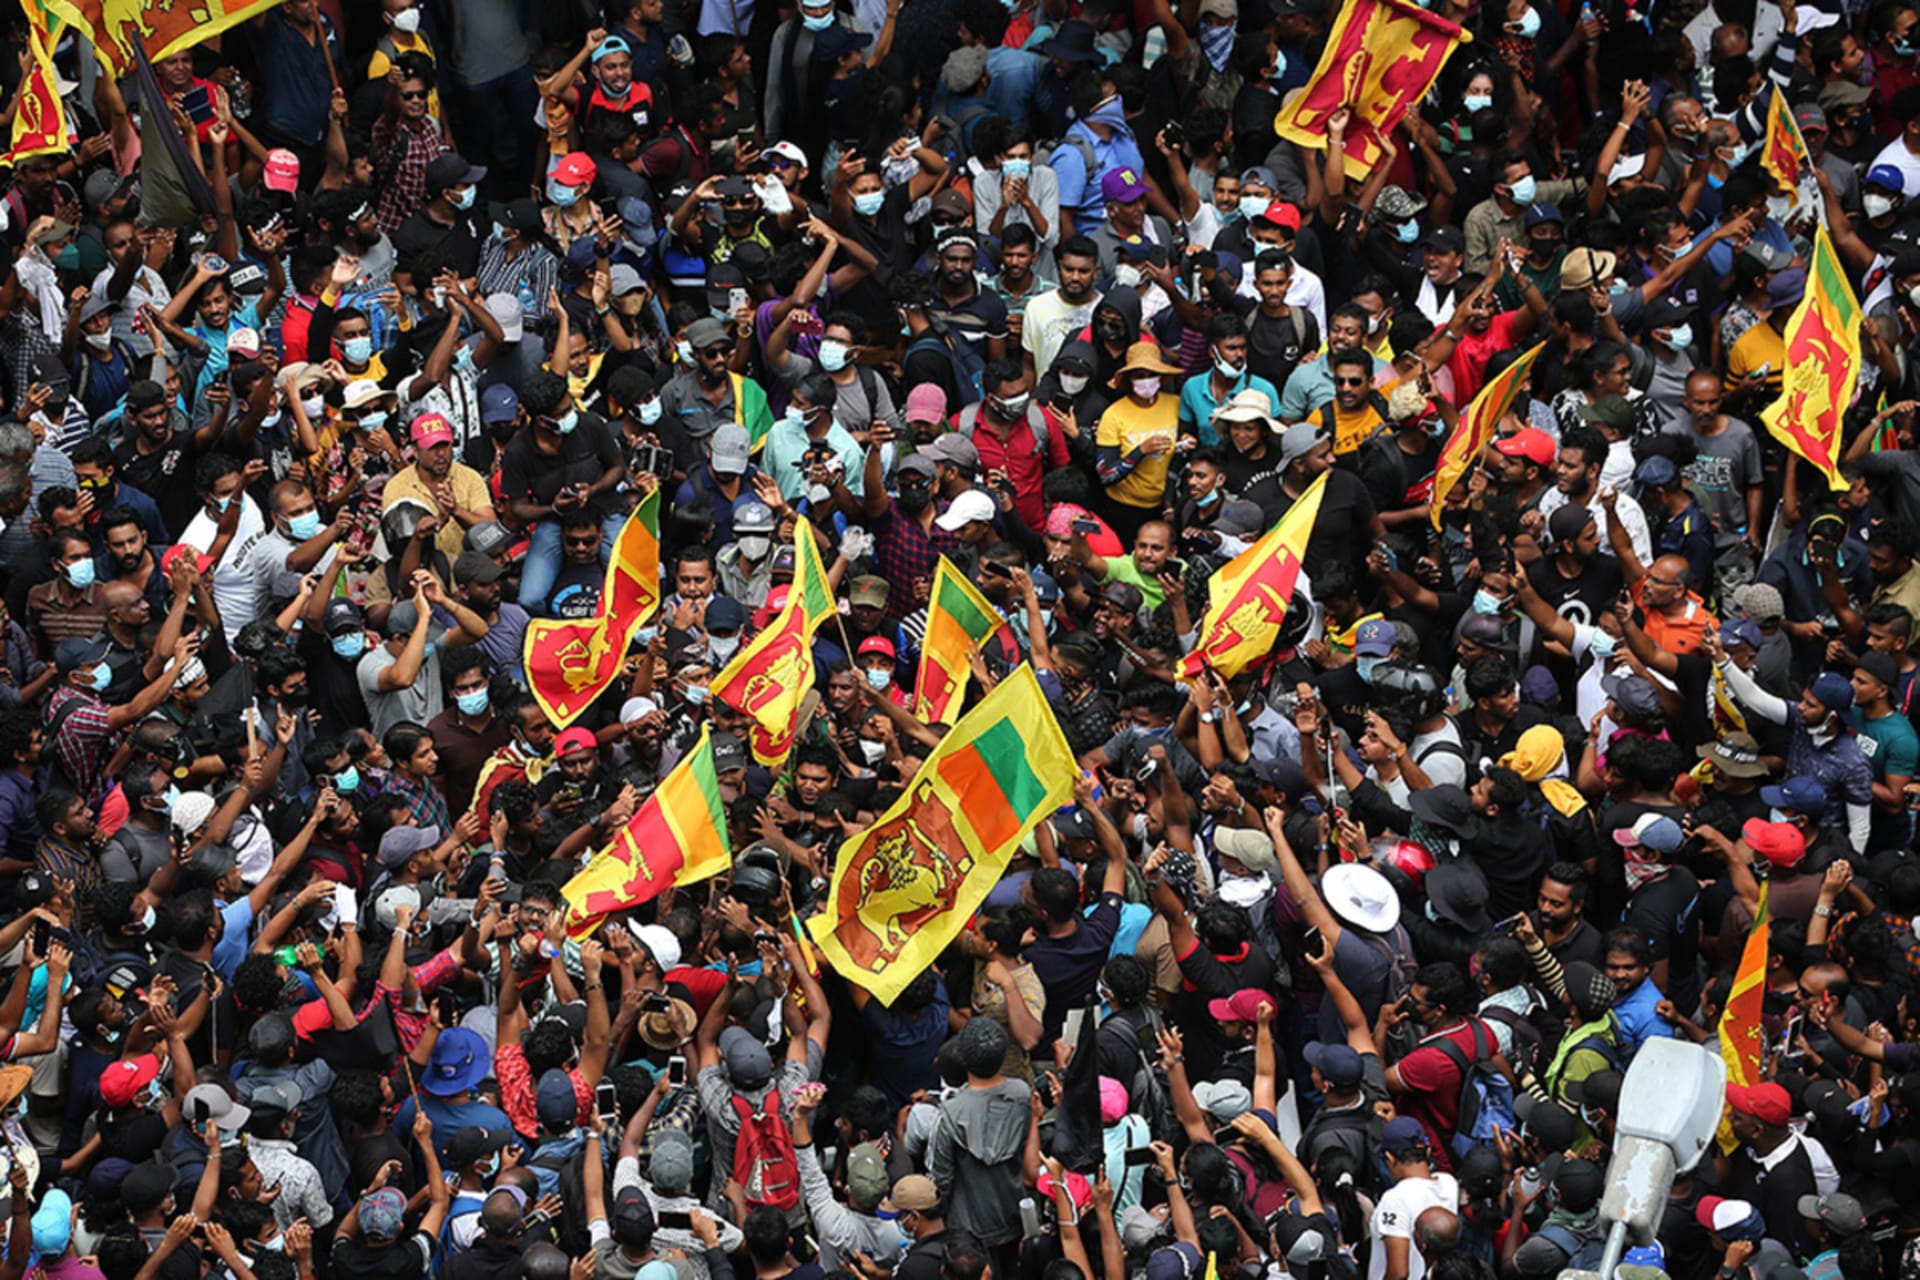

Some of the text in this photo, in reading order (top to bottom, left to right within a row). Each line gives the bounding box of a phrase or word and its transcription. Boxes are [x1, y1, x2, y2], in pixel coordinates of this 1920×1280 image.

[422, 419, 444, 434] FBI
[232, 536, 257, 568] ROUTE
[1382, 1212, 1397, 1225] 32
